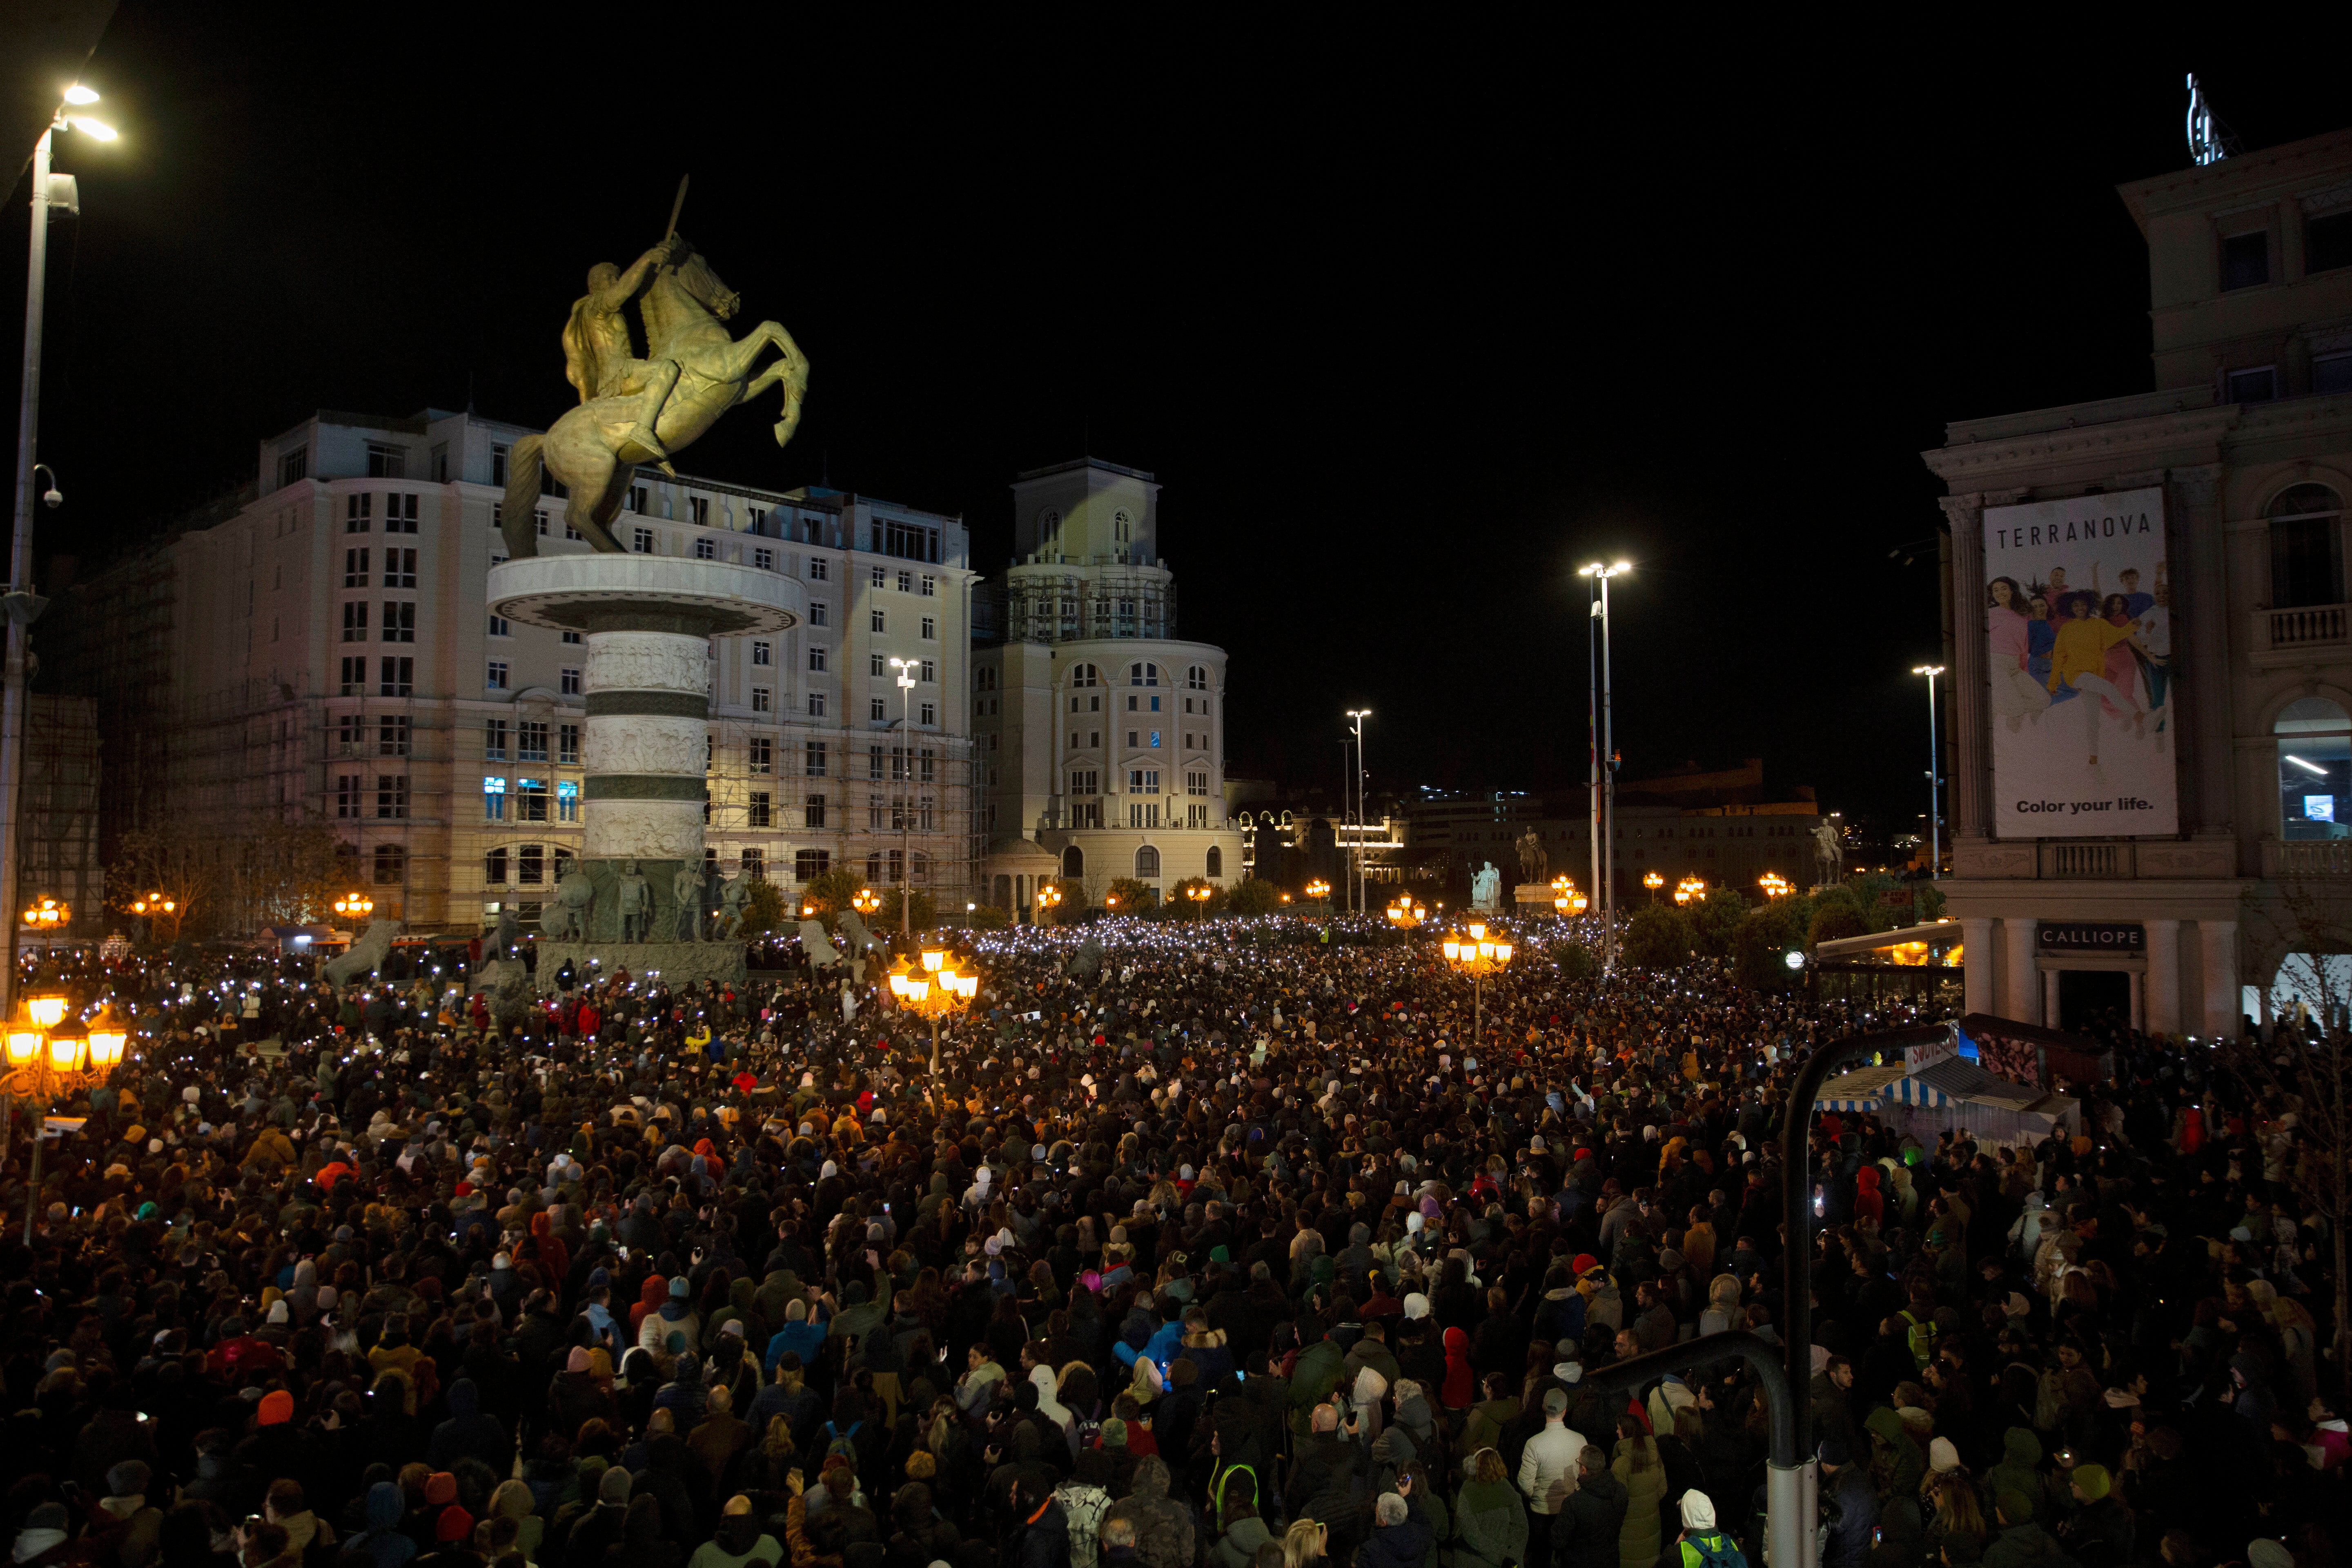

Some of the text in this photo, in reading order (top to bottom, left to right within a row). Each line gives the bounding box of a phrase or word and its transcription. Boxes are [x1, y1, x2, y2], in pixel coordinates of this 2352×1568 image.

[1997, 513, 2151, 549] TERRANOVA
[2017, 797, 2154, 815] Color your life.
[2042, 930, 2139, 944] CALLIOPE
